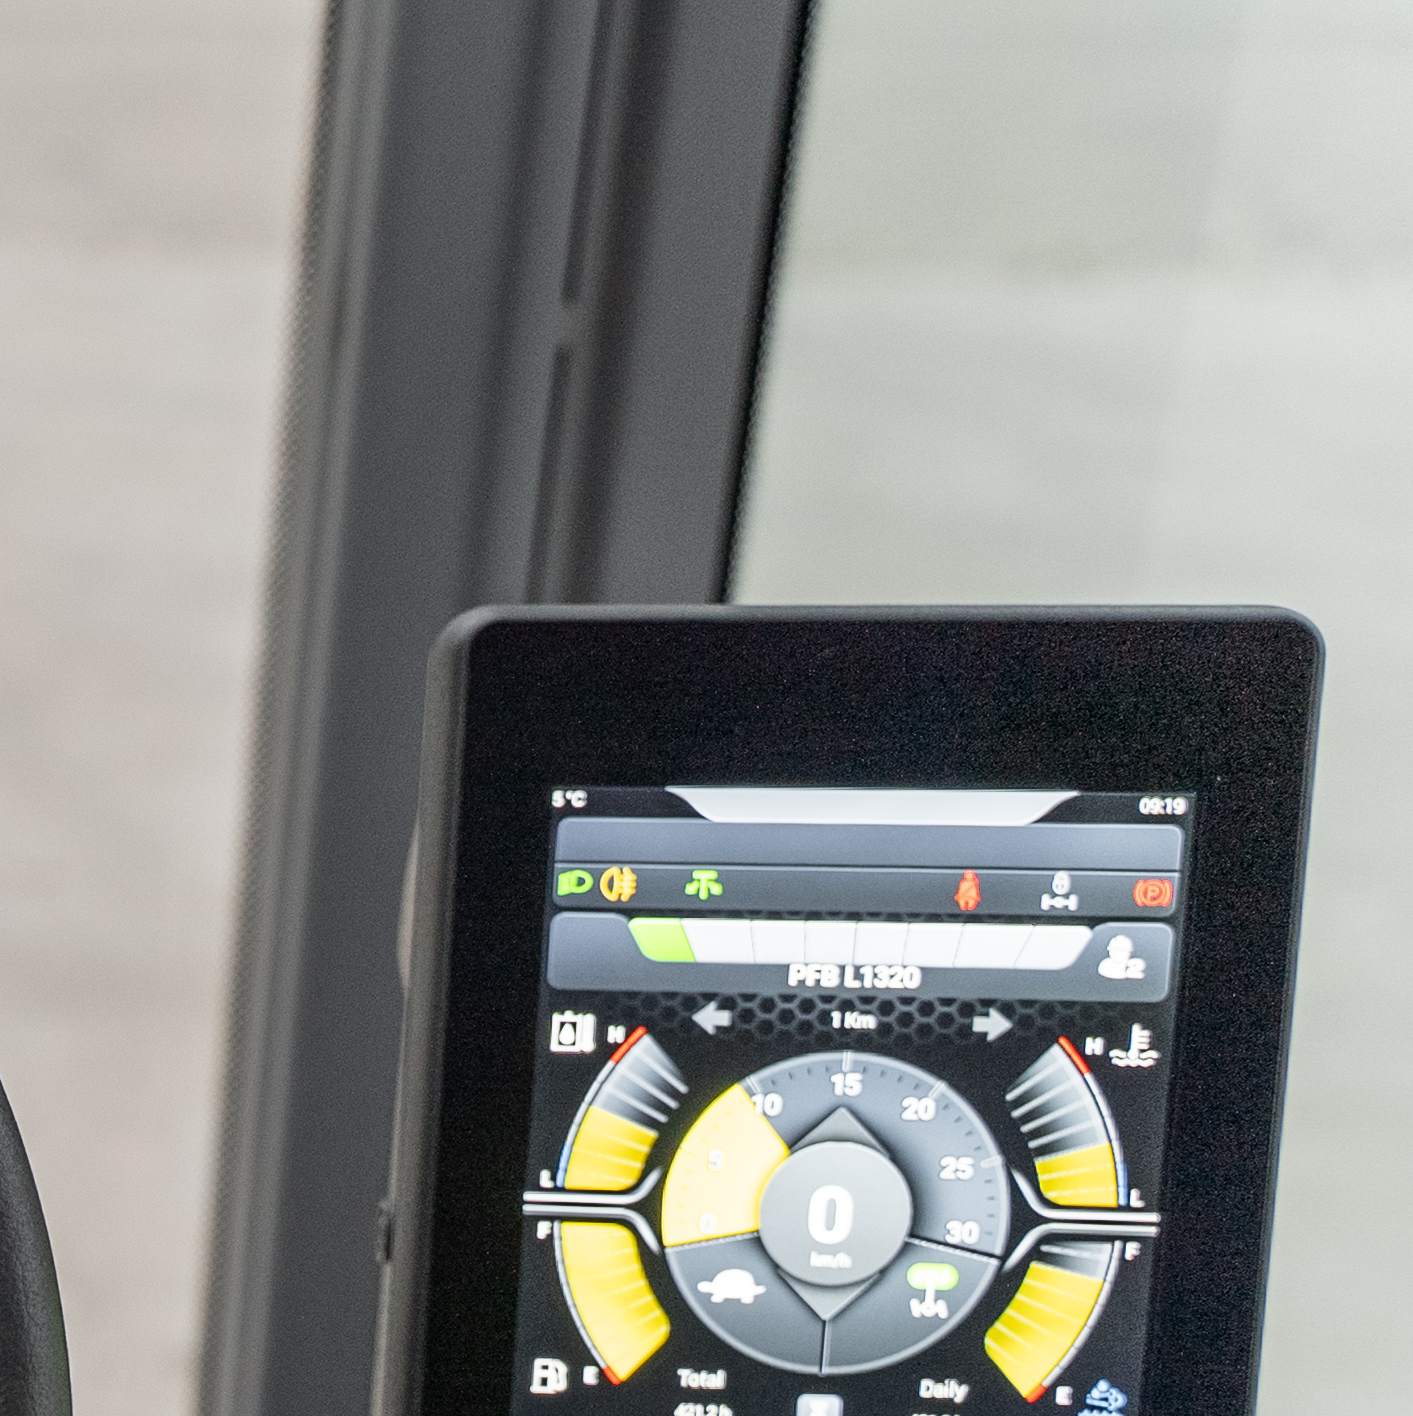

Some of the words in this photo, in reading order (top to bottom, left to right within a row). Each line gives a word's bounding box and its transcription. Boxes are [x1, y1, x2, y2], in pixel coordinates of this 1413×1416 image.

[1138, 796, 1187, 815] 09:19
[787, 963, 841, 988] PFB
[843, 964, 922, 989] L1320
[607, 1024, 626, 1044] H
[1085, 1037, 1104, 1055] H
[830, 1072, 863, 1097] 15
[751, 1092, 783, 1117] 10
[901, 1096, 936, 1122] 20
[707, 1149, 725, 1171] 5
[939, 1156, 974, 1180] 25
[539, 1169, 555, 1188] L
[1129, 1188, 1145, 1208] L
[698, 1212, 717, 1235] 0
[807, 1184, 854, 1245] 0
[944, 1220, 980, 1244] 30
[677, 1368, 726, 1389] Total
[919, 1378, 969, 1404] Daily
